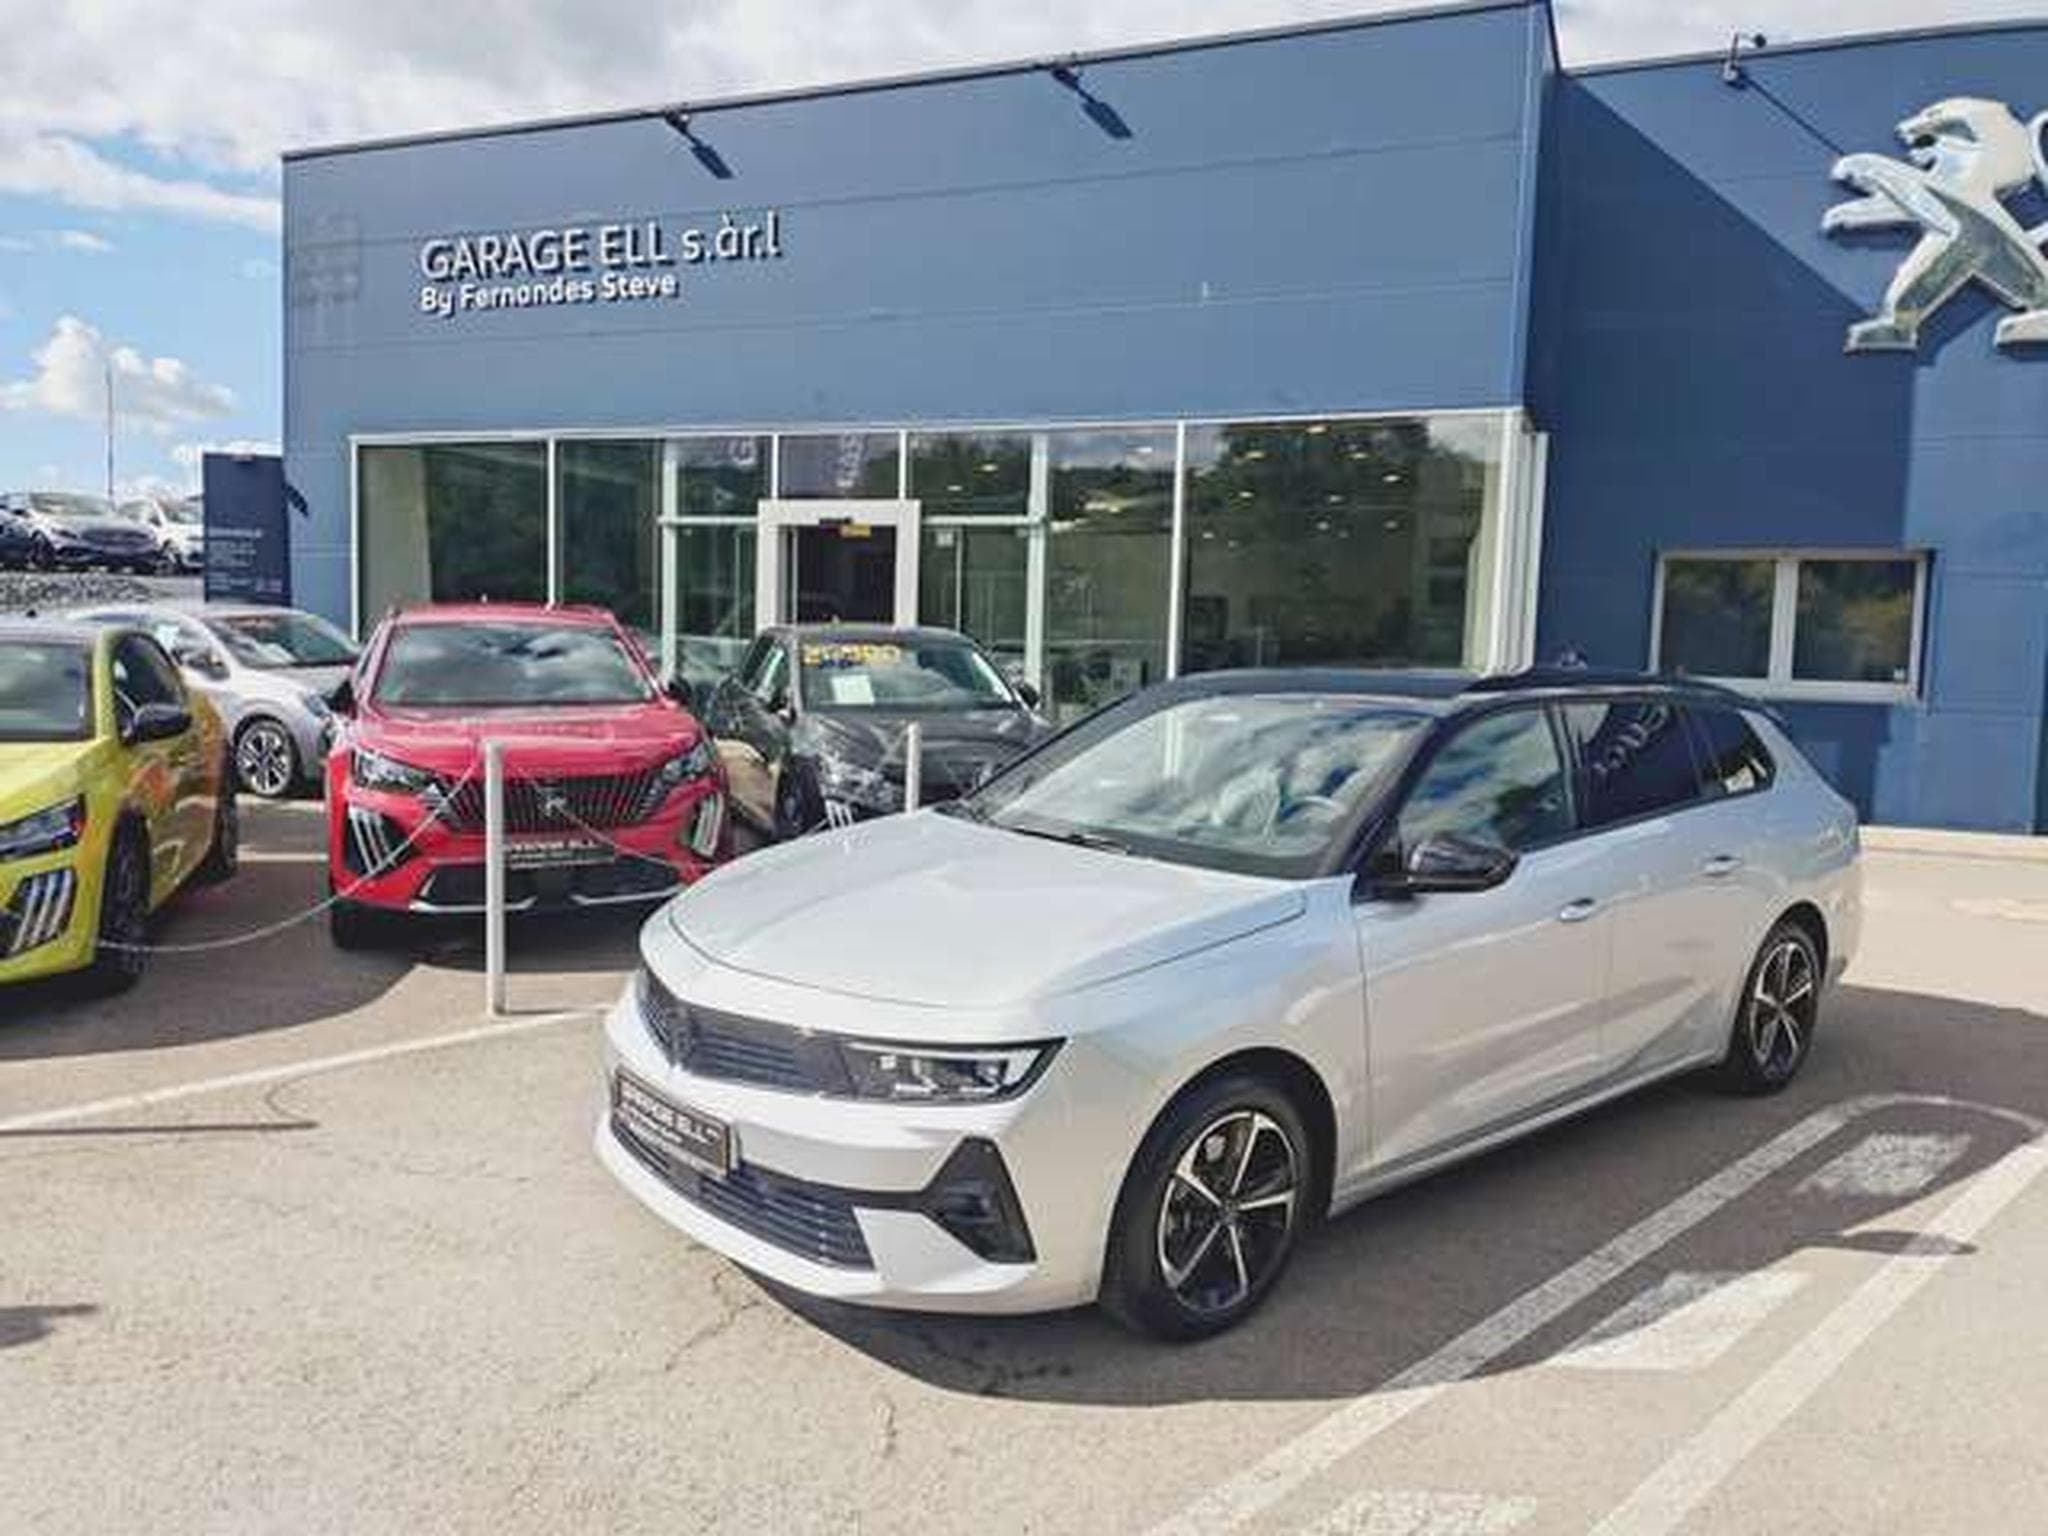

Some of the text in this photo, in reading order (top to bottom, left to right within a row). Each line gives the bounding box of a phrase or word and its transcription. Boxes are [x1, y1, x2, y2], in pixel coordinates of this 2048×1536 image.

[420, 227, 588, 280] GARAGE
[601, 221, 670, 265] ELL
[421, 272, 677, 315] By Fernandes Steve
